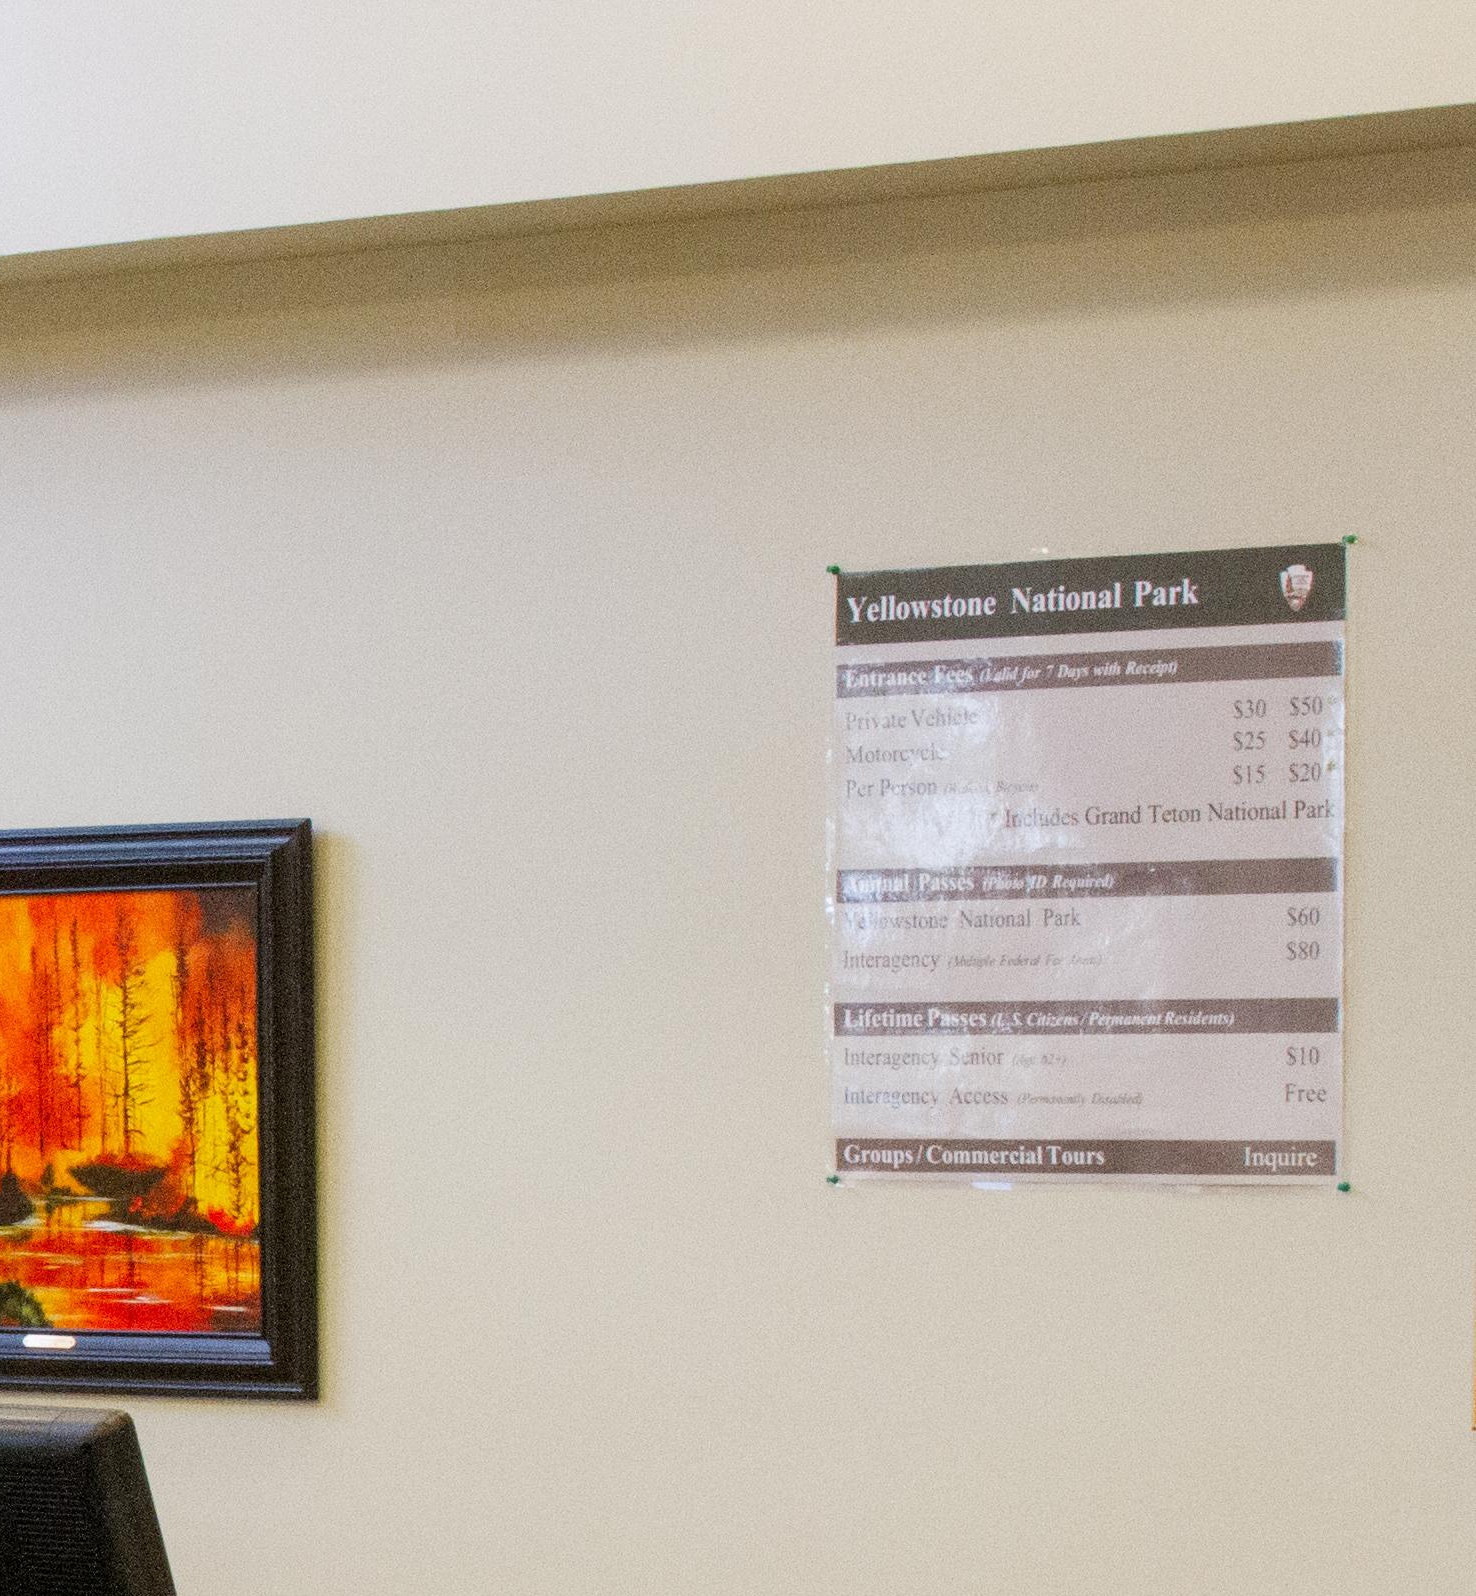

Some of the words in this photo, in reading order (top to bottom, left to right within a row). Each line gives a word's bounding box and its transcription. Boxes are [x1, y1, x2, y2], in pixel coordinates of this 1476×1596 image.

[847, 594, 997, 624] Yellowstone
[1011, 582, 1123, 616] National
[1134, 577, 1200, 608] Park
[845, 668, 926, 689] Entrance
[933, 664, 974, 685] Fees
[846, 711, 907, 731] Private
[911, 706, 979, 728] Vehicle
[1233, 699, 1267, 720] $30
[1288, 696, 1323, 717] $50
[1233, 730, 1266, 751] $25
[1288, 729, 1322, 749] $40
[846, 780, 873, 798] Per
[880, 778, 938, 797] Person
[1233, 764, 1266, 785] $15
[1288, 763, 1322, 783] $20
[1004, 807, 1080, 830] Includes
[1084, 803, 1142, 828] Grand
[1147, 803, 1202, 825] Teton
[1206, 799, 1287, 823] National
[1292, 798, 1336, 820] Park
[918, 873, 975, 891] Passes
[959, 909, 1032, 928] National
[1043, 907, 1082, 927] Park
[1286, 906, 1321, 927] $60
[843, 951, 939, 972] Interagency
[1285, 940, 1321, 961] $80
[844, 1008, 924, 1028] Lifetime
[927, 1008, 988, 1028] Passes
[844, 1048, 939, 1070] Interagency
[949, 1047, 1004, 1066] Senior
[1285, 1046, 1321, 1066] $10
[844, 1087, 939, 1109] Interagency
[949, 1087, 1010, 1106] Access
[1285, 1084, 1328, 1104] Free
[1046, 1144, 1106, 1166] Tours
[1243, 1147, 1318, 1170] Inquire
